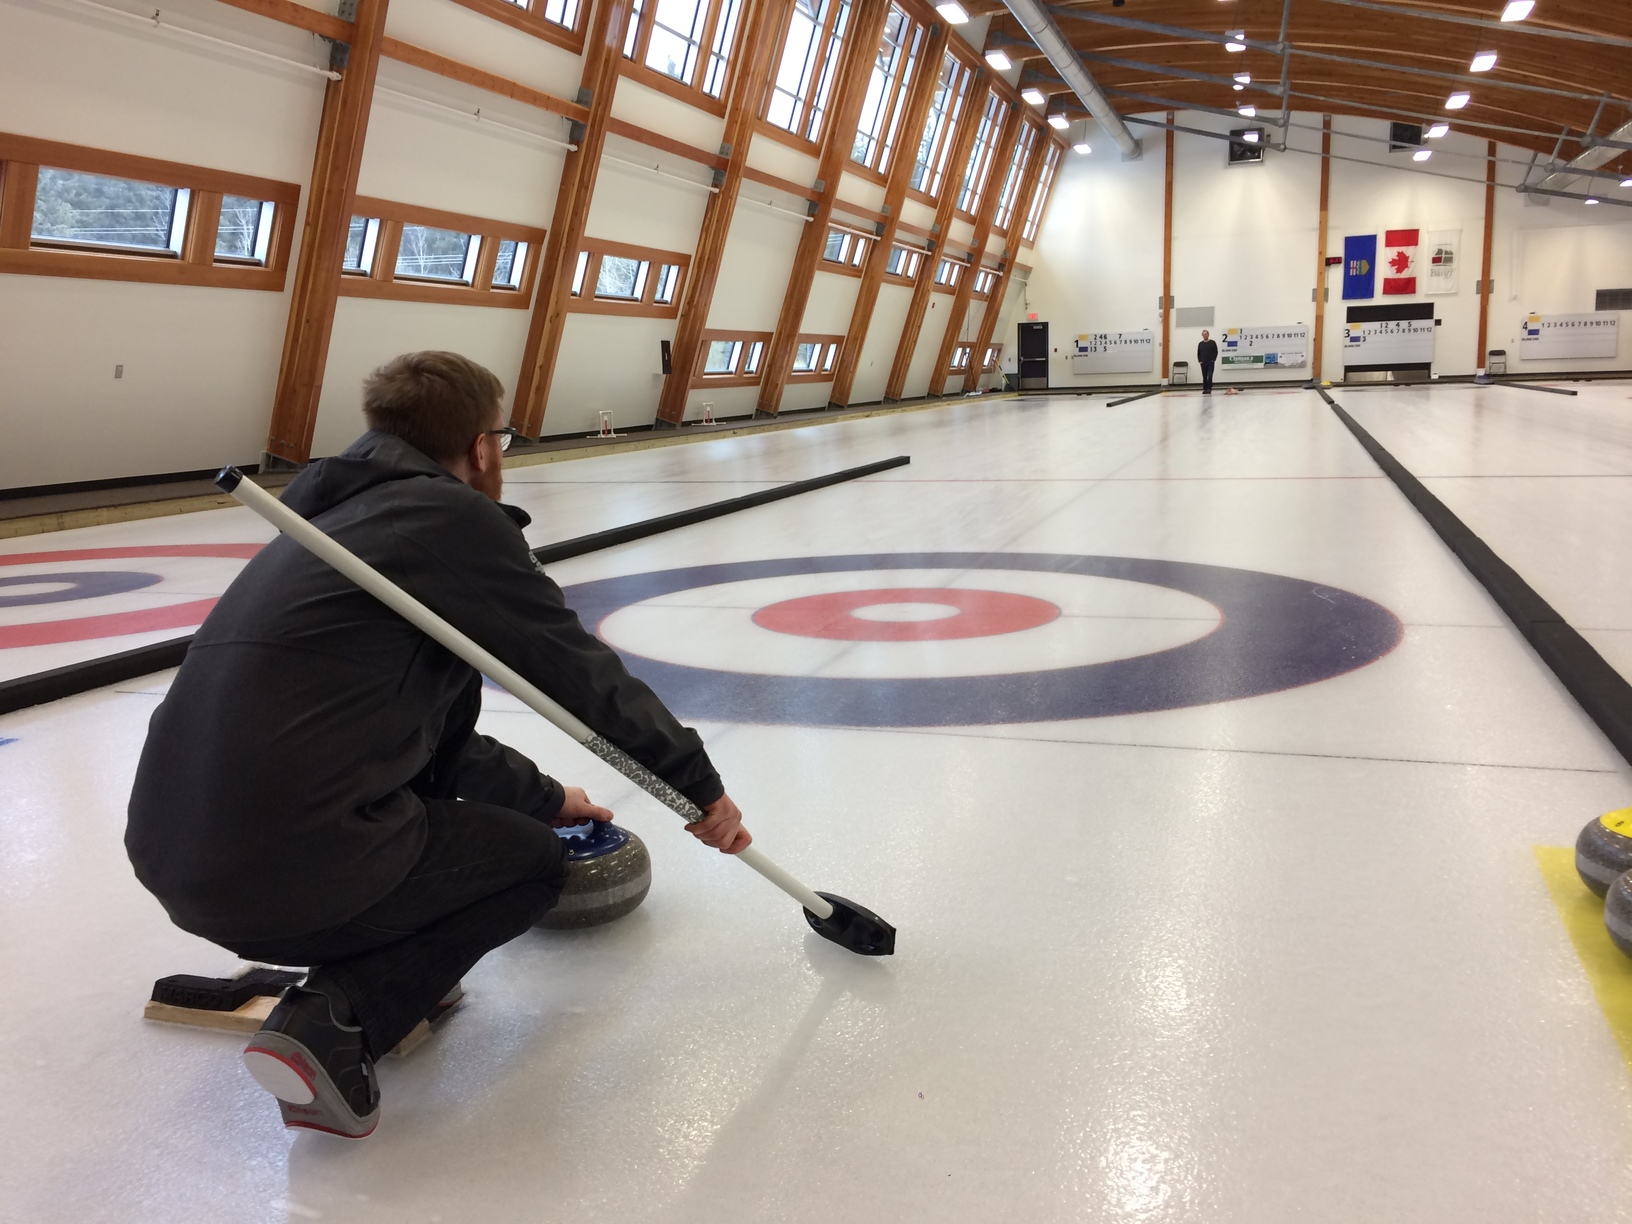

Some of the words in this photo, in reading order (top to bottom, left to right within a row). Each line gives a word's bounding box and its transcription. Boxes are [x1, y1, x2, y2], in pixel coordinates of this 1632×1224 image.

[1430, 268, 1454, 279] Banff
[1522, 321, 1528, 330] 4
[1222, 334, 1228, 342] 2
[1344, 329, 1350, 338] 3
[1074, 340, 1079, 348] 1
